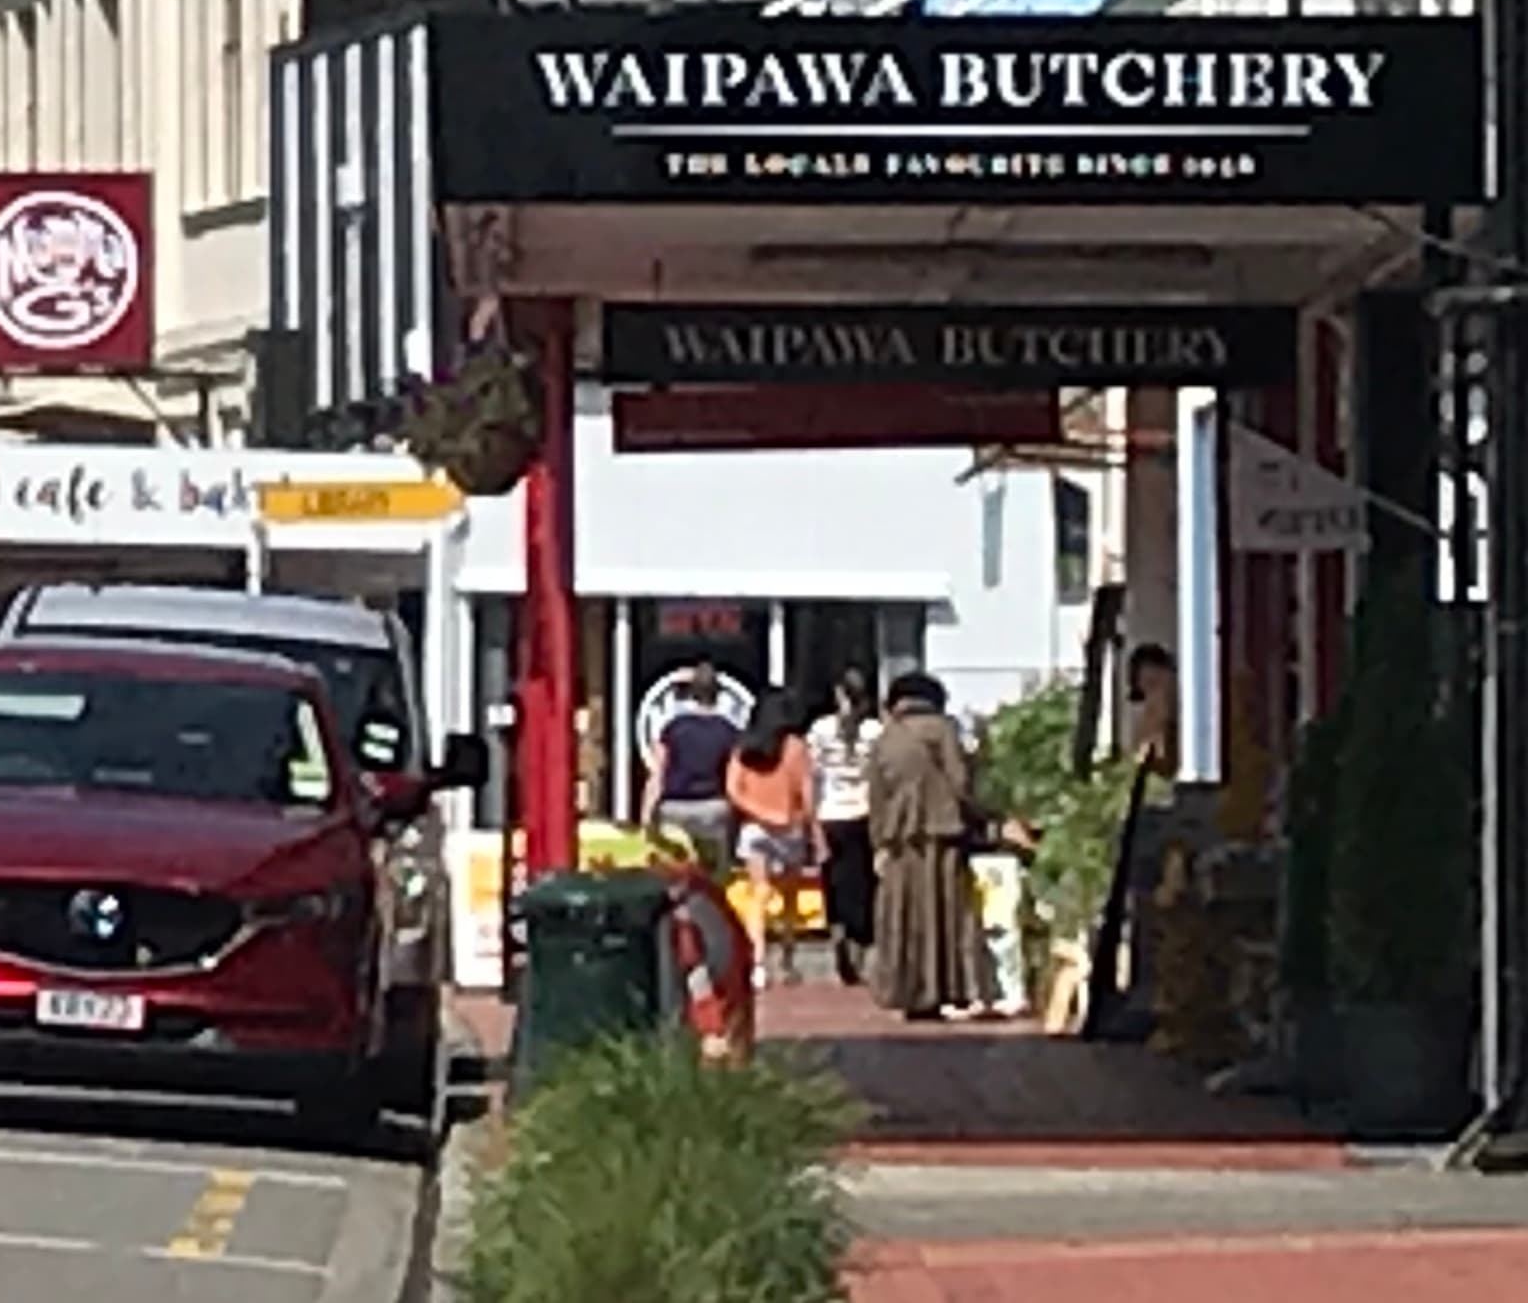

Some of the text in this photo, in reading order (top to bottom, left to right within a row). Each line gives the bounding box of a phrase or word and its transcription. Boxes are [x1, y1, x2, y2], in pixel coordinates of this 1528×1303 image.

[535, 49, 1386, 108] WAIPAWA BUTCHERY
[664, 324, 1229, 366] WAIPAWA BUTCHERY
[14, 464, 106, 525] cafe
